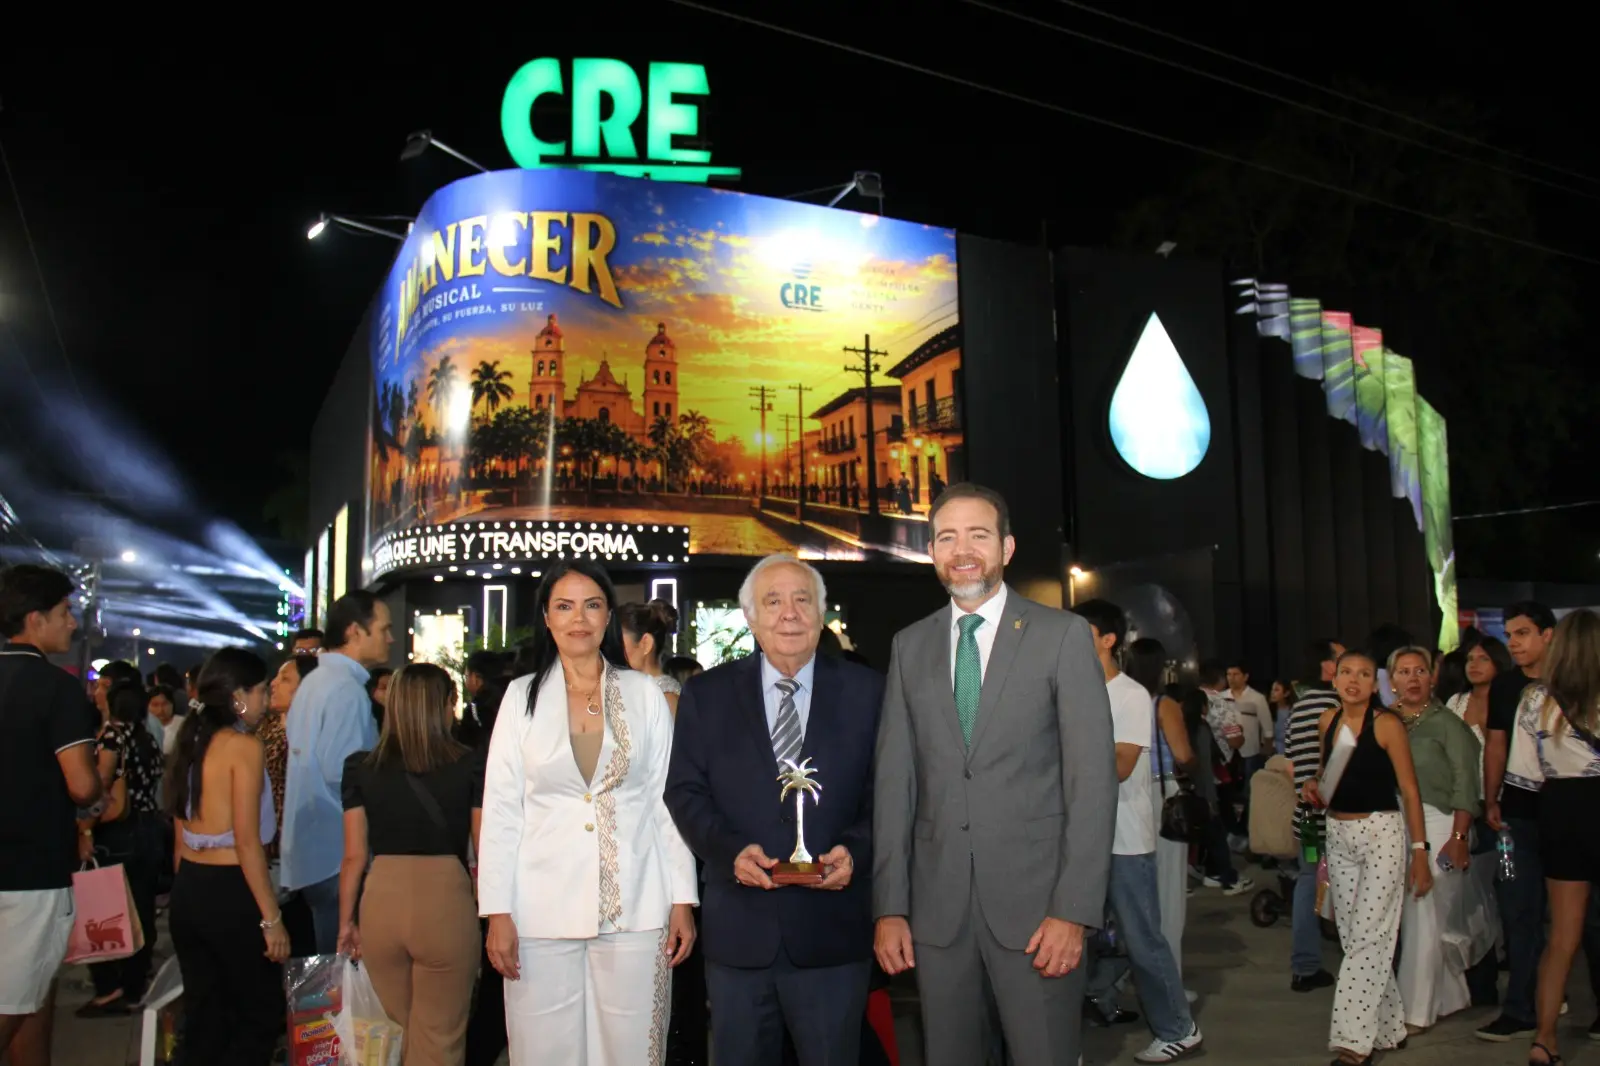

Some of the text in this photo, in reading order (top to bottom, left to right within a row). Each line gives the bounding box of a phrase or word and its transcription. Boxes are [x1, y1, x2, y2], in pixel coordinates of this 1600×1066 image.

[500, 56, 712, 169] CRE
[422, 283, 482, 316] MUSICAL
[500, 302, 516, 312] SU
[520, 301, 544, 312] LUZ
[780, 282, 824, 311] CRE
[393, 537, 417, 561] QUE
[420, 533, 456, 557] UNE
[460, 532, 476, 553] Y
[479, 530, 639, 555] TRANSFORMA
